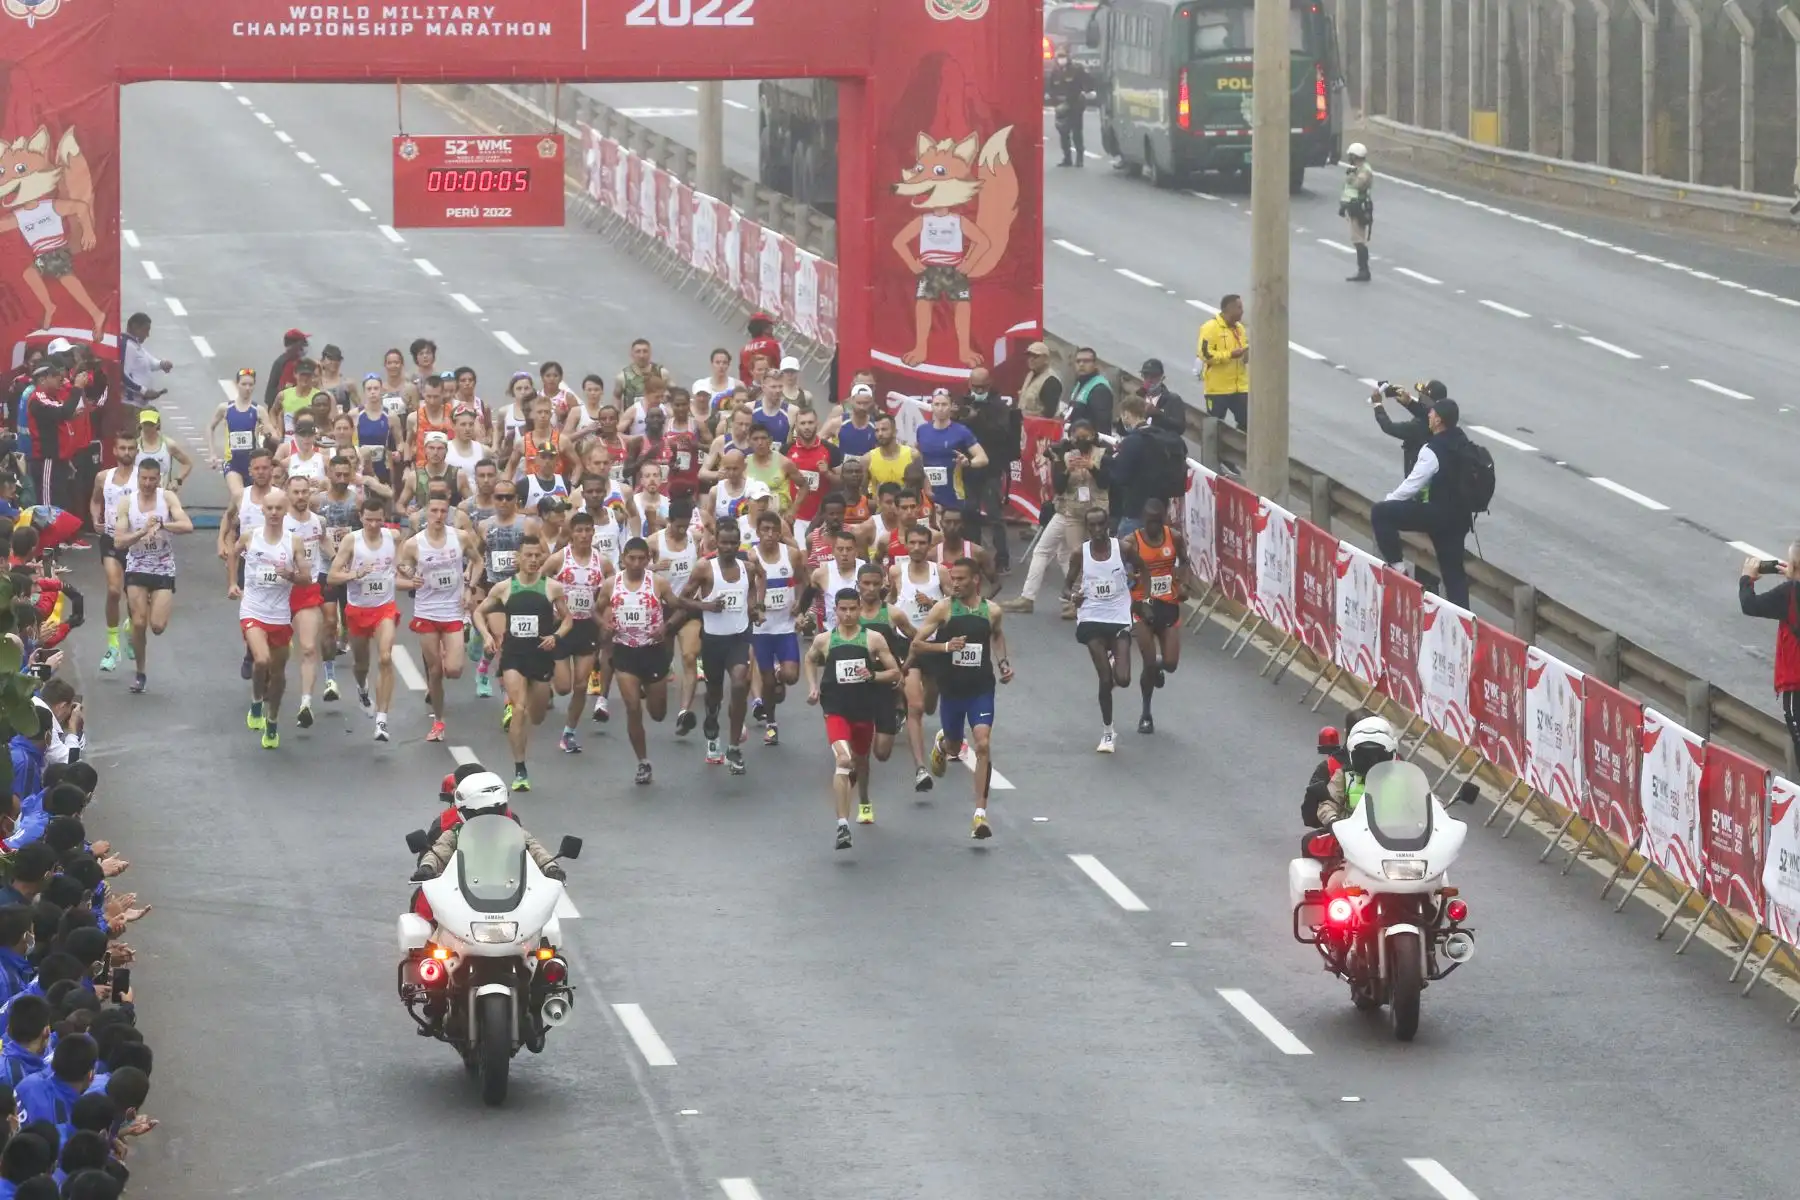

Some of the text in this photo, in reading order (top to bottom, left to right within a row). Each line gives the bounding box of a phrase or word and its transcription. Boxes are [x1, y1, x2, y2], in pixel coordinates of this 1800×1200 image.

[289, 6, 496, 20] WORLD MILITARY
[625, 0, 755, 26] 2022
[232, 22, 552, 36] CHAMPIONSHIP MARATHON
[477, 139, 512, 150] WMC
[427, 171, 527, 191] 00:00:05
[446, 206, 512, 218] PERÚ 2022
[236, 437, 246, 445] 36
[929, 472, 942, 481] 153
[674, 562, 688, 571] 146
[264, 572, 278, 582] 142
[438, 576, 451, 586] 141
[368, 582, 383, 591] 144
[1096, 584, 1111, 594] 104
[1153, 583, 1167, 591] 125
[575, 598, 590, 607] 139
[727, 596, 737, 605] 27
[771, 594, 784, 604] 112
[624, 612, 640, 621] 140
[518, 622, 532, 632] 127
[960, 650, 976, 661] 130
